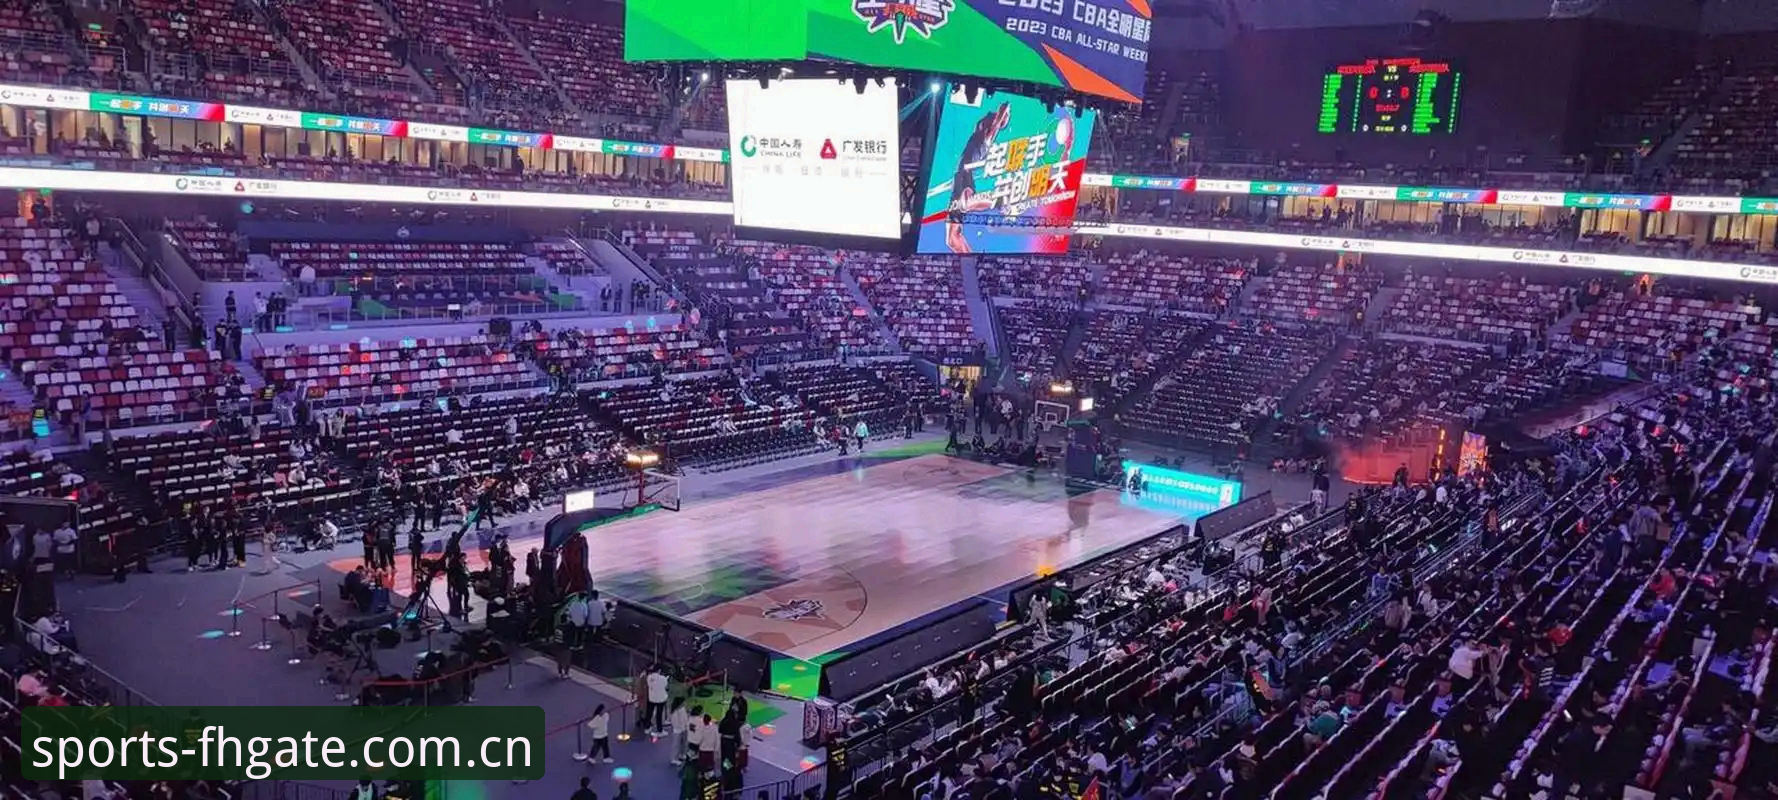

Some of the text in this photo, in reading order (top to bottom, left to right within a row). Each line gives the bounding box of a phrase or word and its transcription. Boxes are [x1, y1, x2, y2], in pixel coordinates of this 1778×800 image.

[1006, 17, 1148, 62] 2023 CBA ALL-STAR WEEK
[759, 137, 802, 149] 中国人寿
[842, 140, 887, 154] 广发银行
[992, 160, 1071, 204] 共创明天
